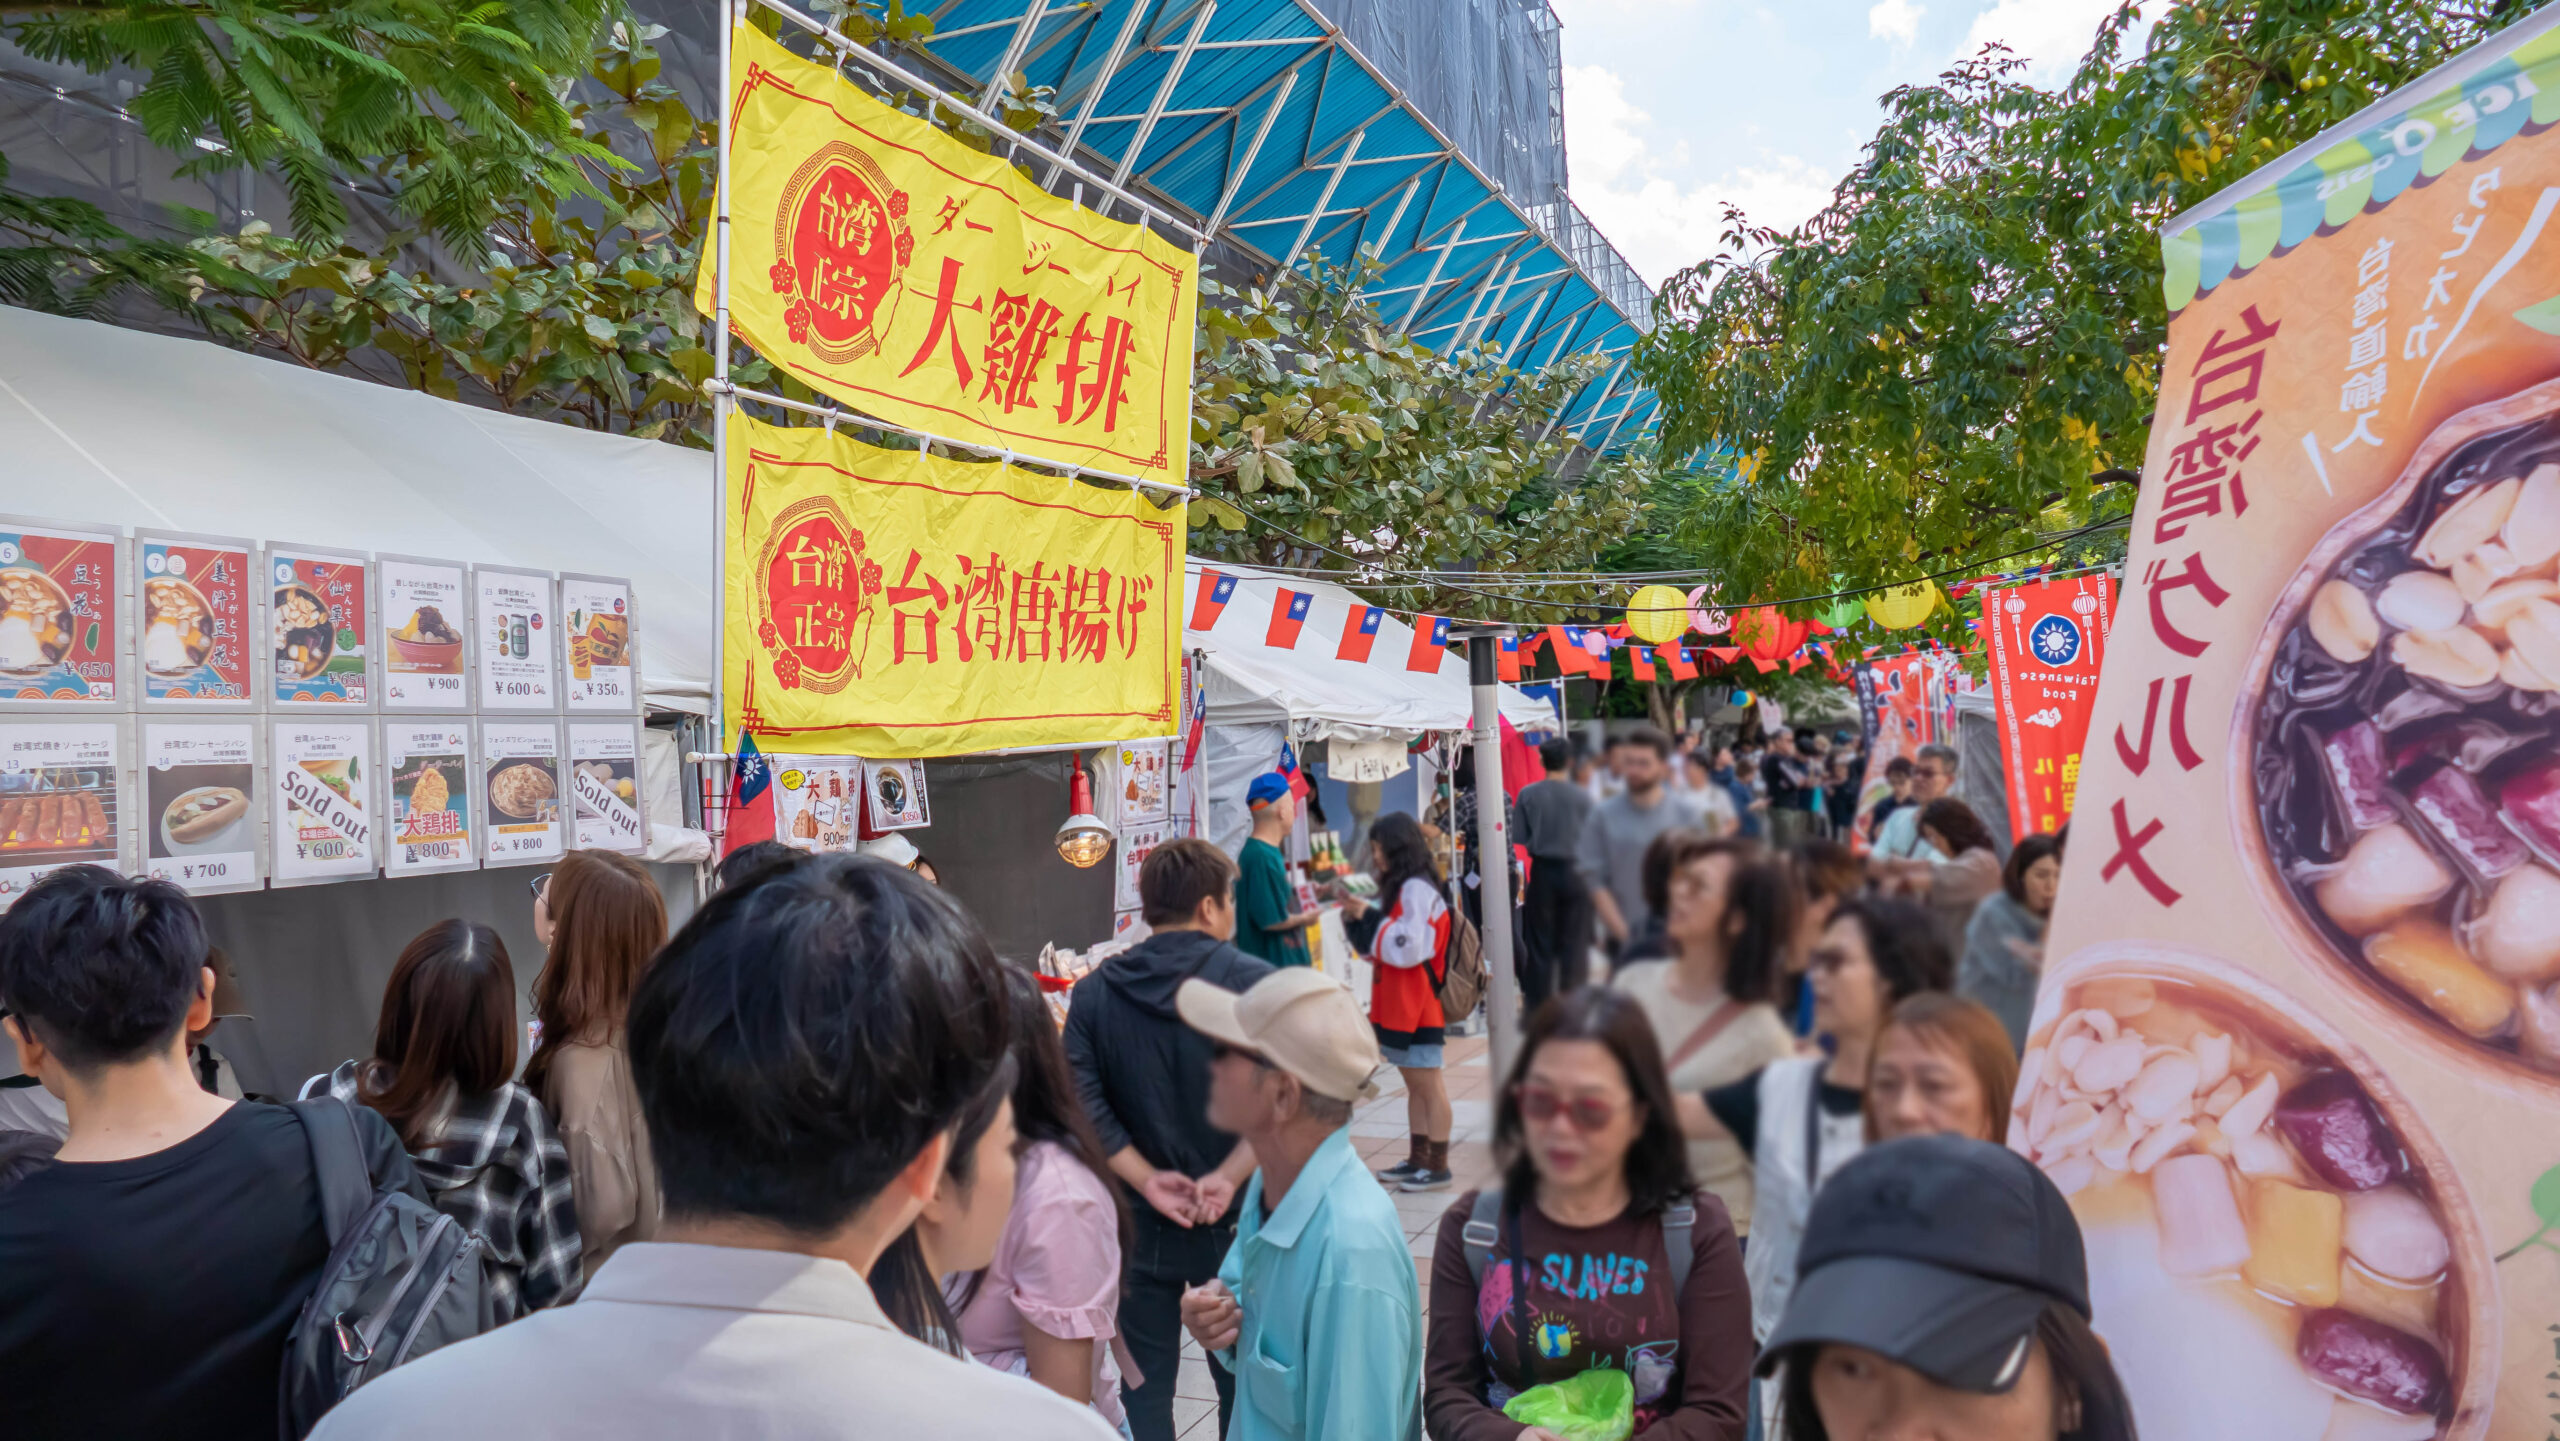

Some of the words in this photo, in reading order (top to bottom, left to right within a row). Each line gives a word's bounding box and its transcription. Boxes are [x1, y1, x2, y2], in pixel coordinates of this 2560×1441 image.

[898, 255, 1136, 432] 大雞排
[3, 548, 11, 559] 6
[153, 558, 159, 568] 7
[281, 569, 287, 578] 8
[785, 535, 848, 592] 台湾
[70, 564, 93, 616] 豆花
[328, 581, 345, 627] 仙草
[886, 548, 1154, 665] 台湾唐揚げ
[790, 600, 846, 652] 正宗
[6, 760, 19, 769] 13
[280, 771, 332, 816] Sold
[331, 811, 368, 844] out
[403, 810, 460, 837] 大鶏排
[575, 776, 611, 813] Sold
[612, 809, 638, 836] out
[1541, 1252, 1648, 1301] SLAVES
